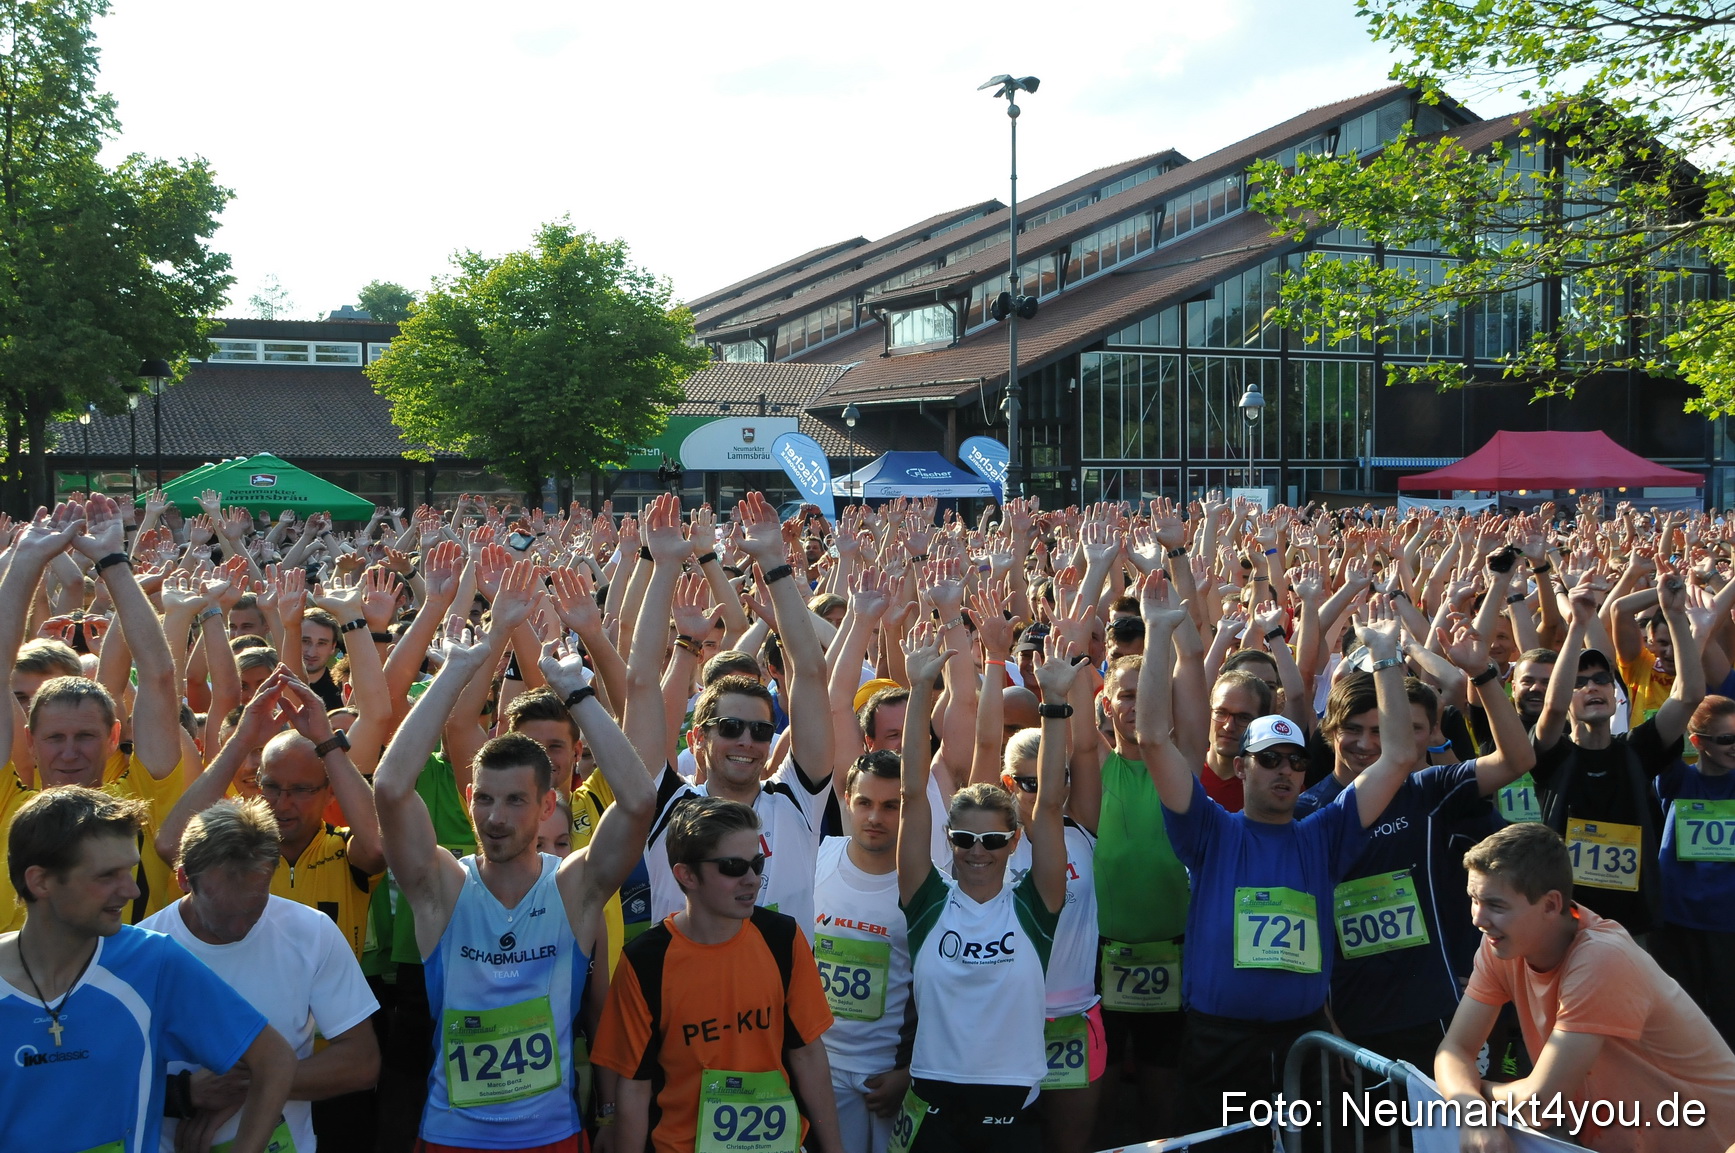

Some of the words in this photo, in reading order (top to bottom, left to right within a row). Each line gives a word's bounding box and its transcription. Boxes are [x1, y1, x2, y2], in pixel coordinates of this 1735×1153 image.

[727, 452, 771, 460] Lammsbräu
[1686, 821, 1735, 846] 707
[1568, 842, 1637, 875] 1133
[834, 917, 891, 938] KLEBL
[1248, 915, 1305, 951] 721
[1342, 905, 1416, 947] 5087
[492, 969, 519, 979] TEAM
[817, 961, 872, 1001] 558
[1113, 966, 1169, 995] 729
[48, 1049, 90, 1063] classic
[449, 1032, 553, 1082] 1249
[479, 1088, 514, 1097] Schabmüller
[514, 1084, 532, 1092] GmbH
[713, 1104, 787, 1142] 929
[726, 1143, 755, 1151] Christoph
